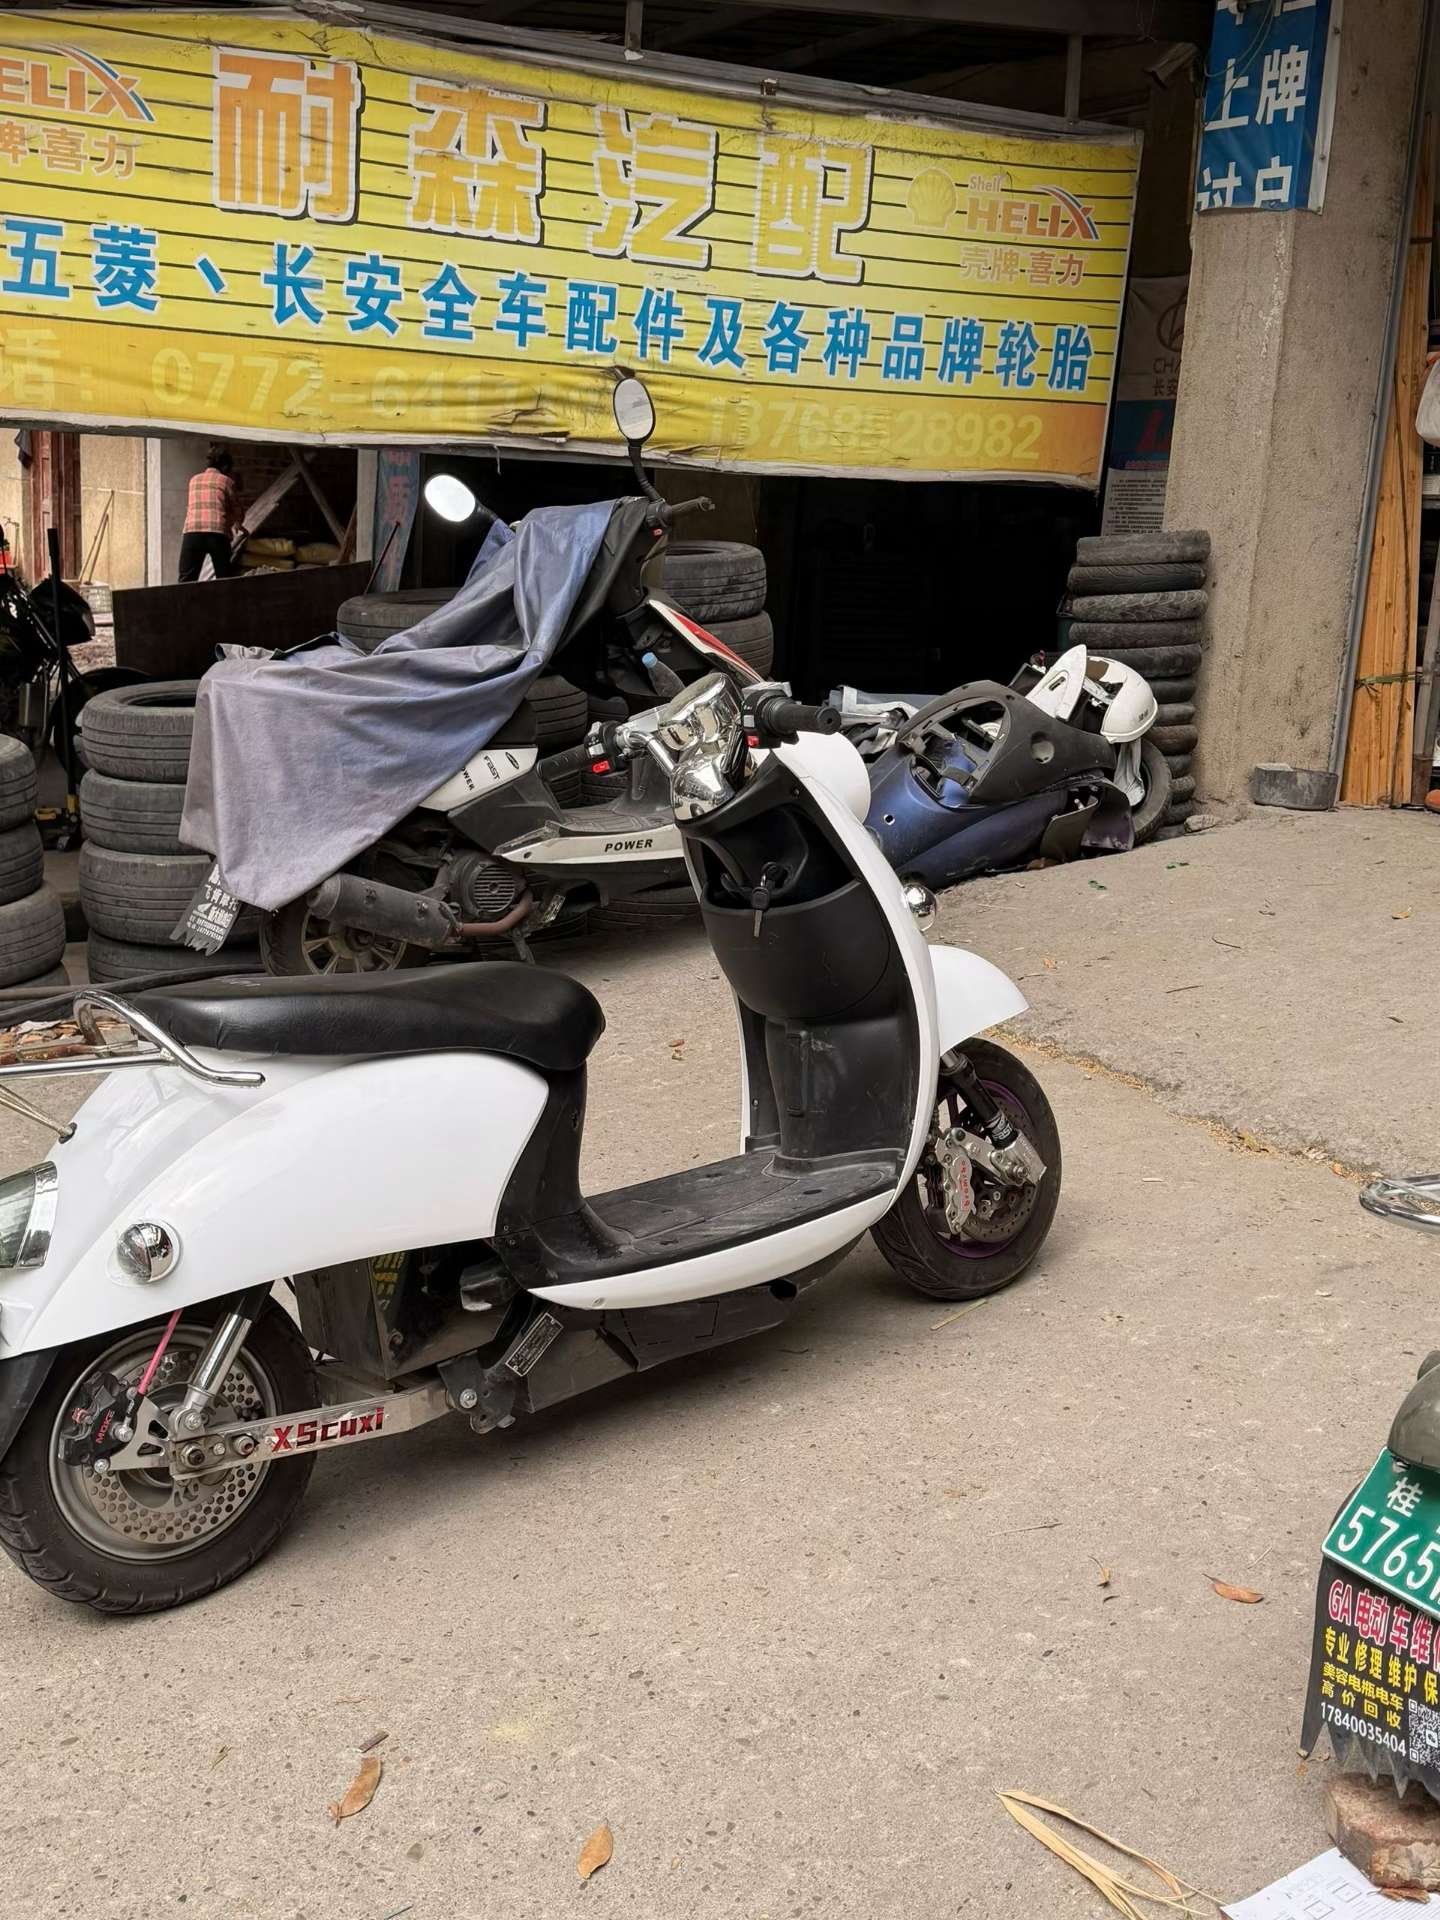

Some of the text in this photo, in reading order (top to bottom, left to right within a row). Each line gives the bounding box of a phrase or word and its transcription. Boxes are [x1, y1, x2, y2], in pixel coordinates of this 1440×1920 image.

[1204, 44, 1309, 132] 上牌
[212, 46, 875, 286] 耐森汽配
[969, 174, 1001, 193] Shell
[966, 185, 1102, 241] HELIX
[960, 246, 1084, 288] 壳牌喜力
[604, 838, 653, 852] POWER
[1386, 1476, 1424, 1518] 桂
[1338, 1504, 1440, 1605] 5765
[1325, 1625, 1350, 1664] 专业
[1355, 1639, 1383, 1680] 修理
[1388, 1653, 1417, 1694] 维护
[1321, 1701, 1407, 1757] 17840035404
